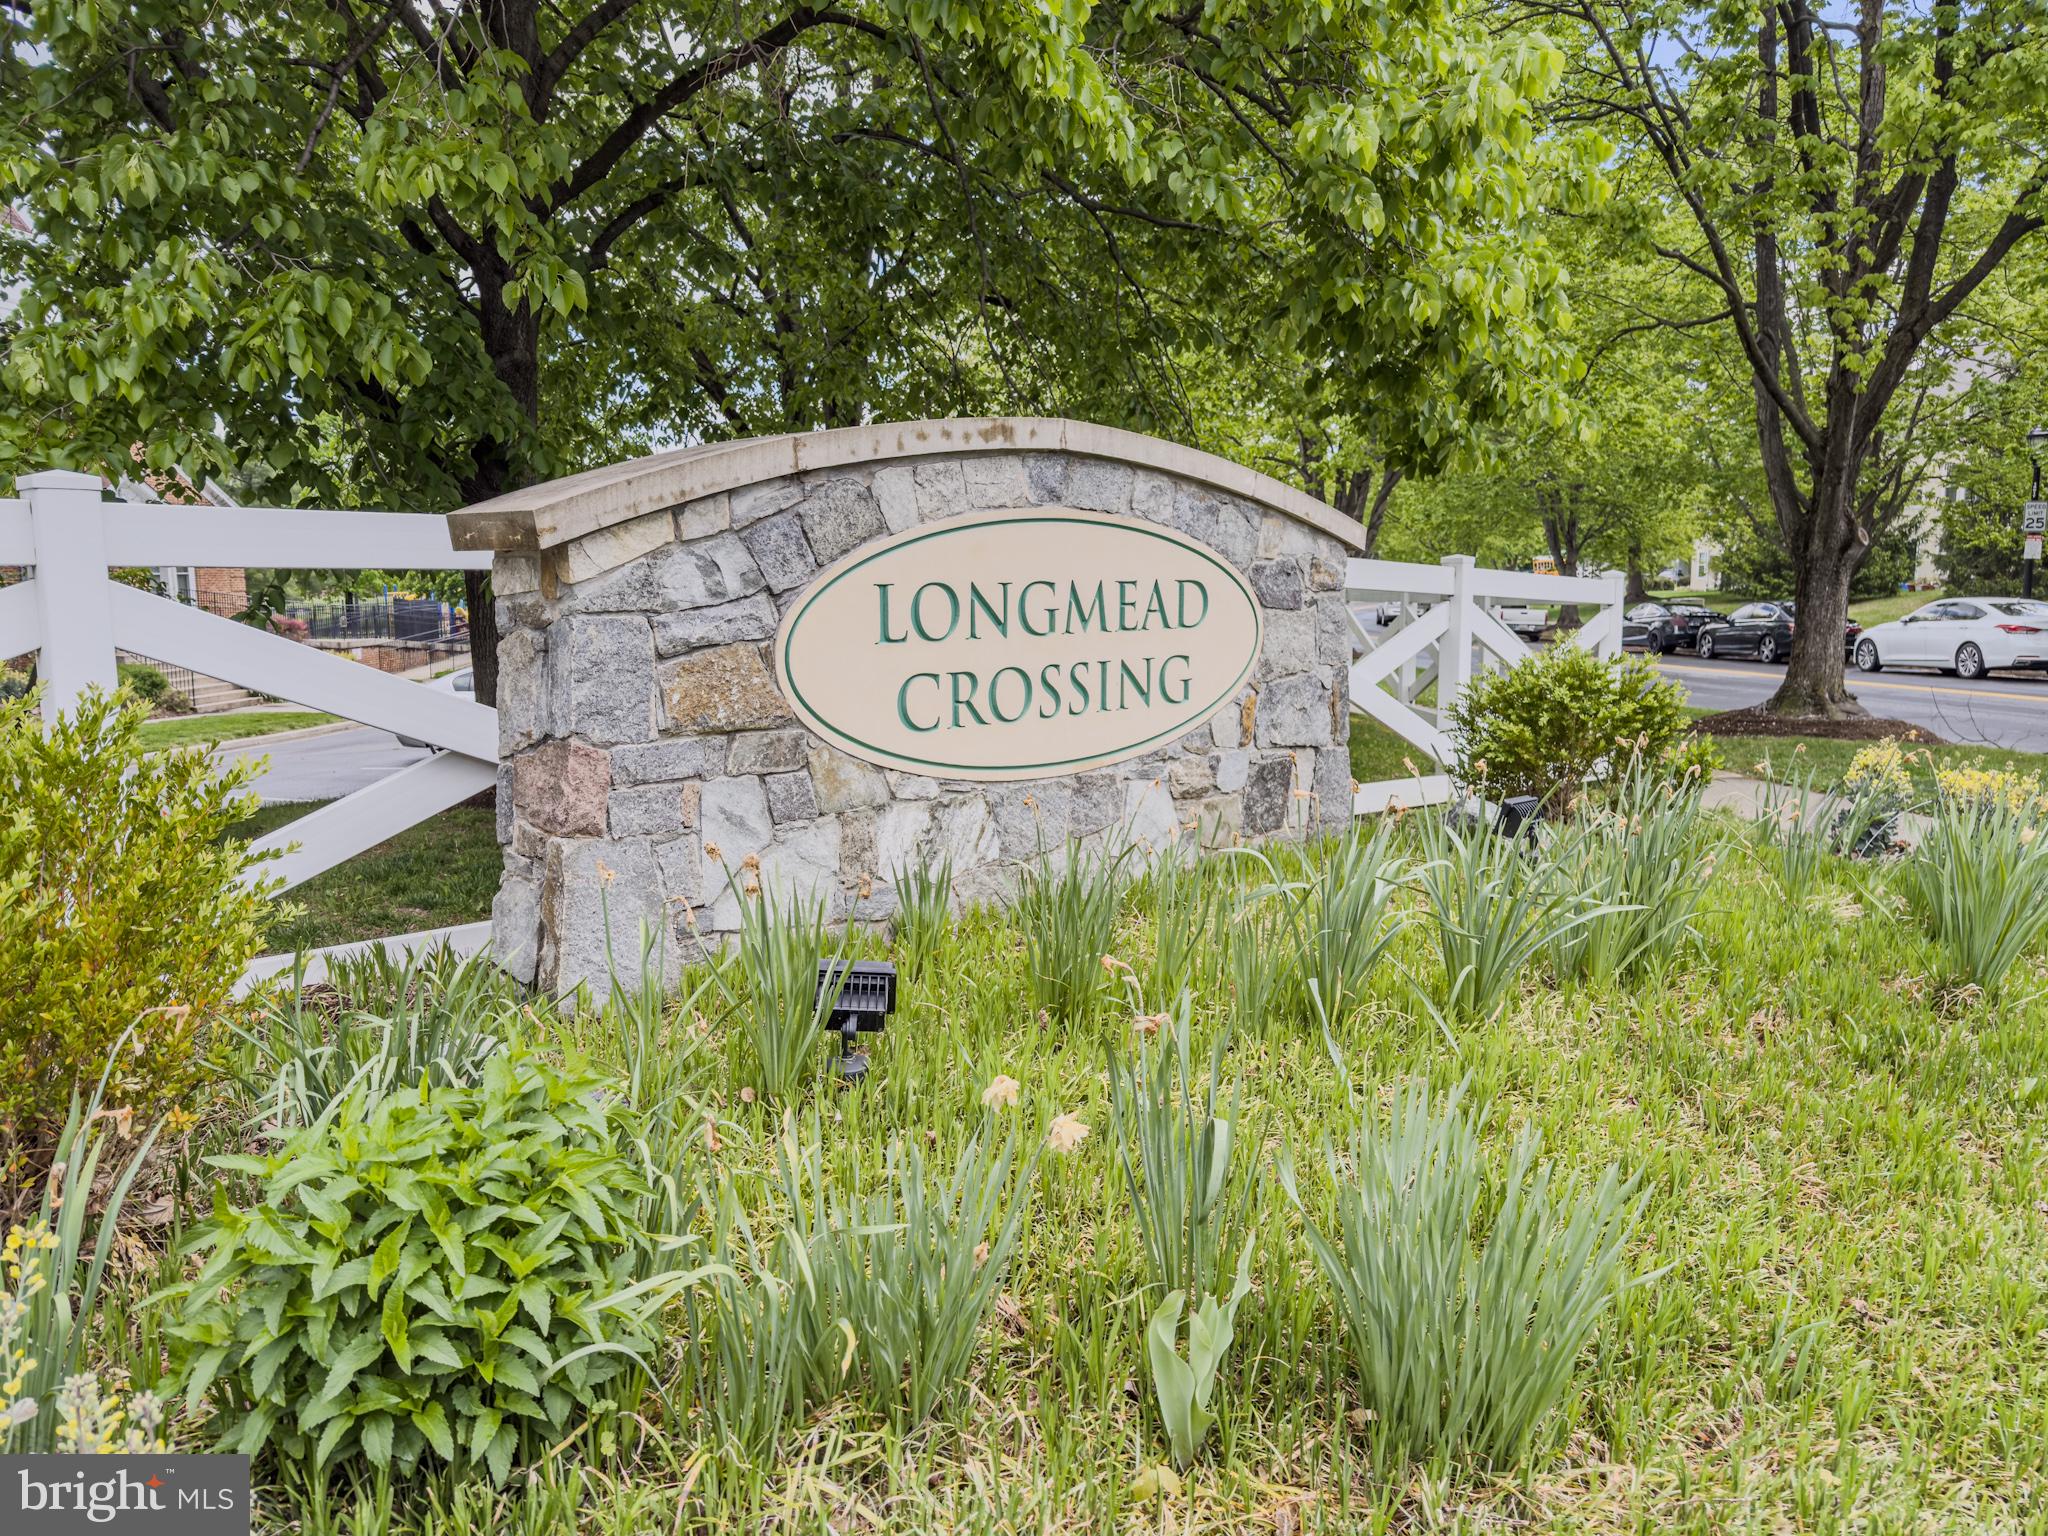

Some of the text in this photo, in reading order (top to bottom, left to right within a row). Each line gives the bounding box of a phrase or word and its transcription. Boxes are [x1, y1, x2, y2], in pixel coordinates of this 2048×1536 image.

[2025, 517, 2045, 529] 25
[874, 578, 1209, 645] LONGMEAD
[897, 655, 1193, 733] CROSSING
